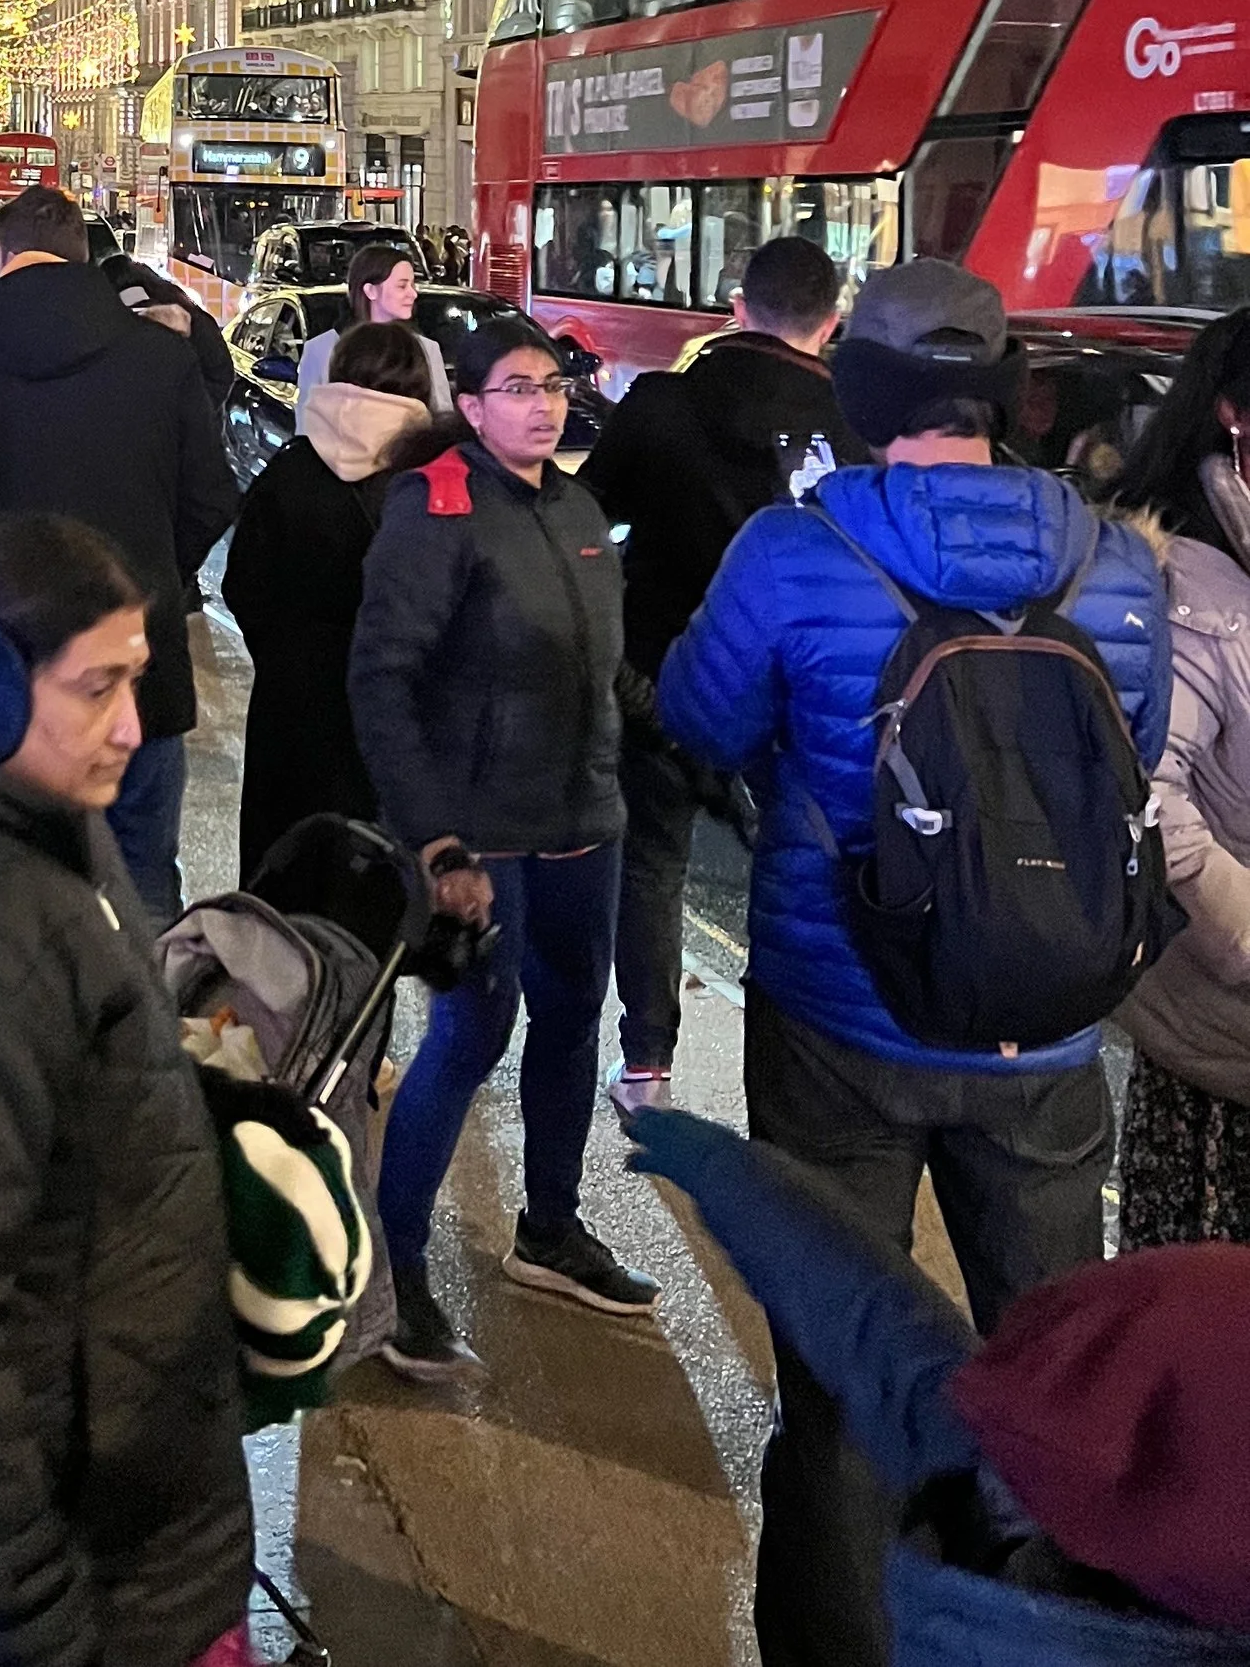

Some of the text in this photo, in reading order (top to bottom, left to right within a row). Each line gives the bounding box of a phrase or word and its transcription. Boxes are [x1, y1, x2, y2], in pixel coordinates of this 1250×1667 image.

[1125, 17, 1180, 79] Go
[202, 147, 310, 170] Hammersmith 9
